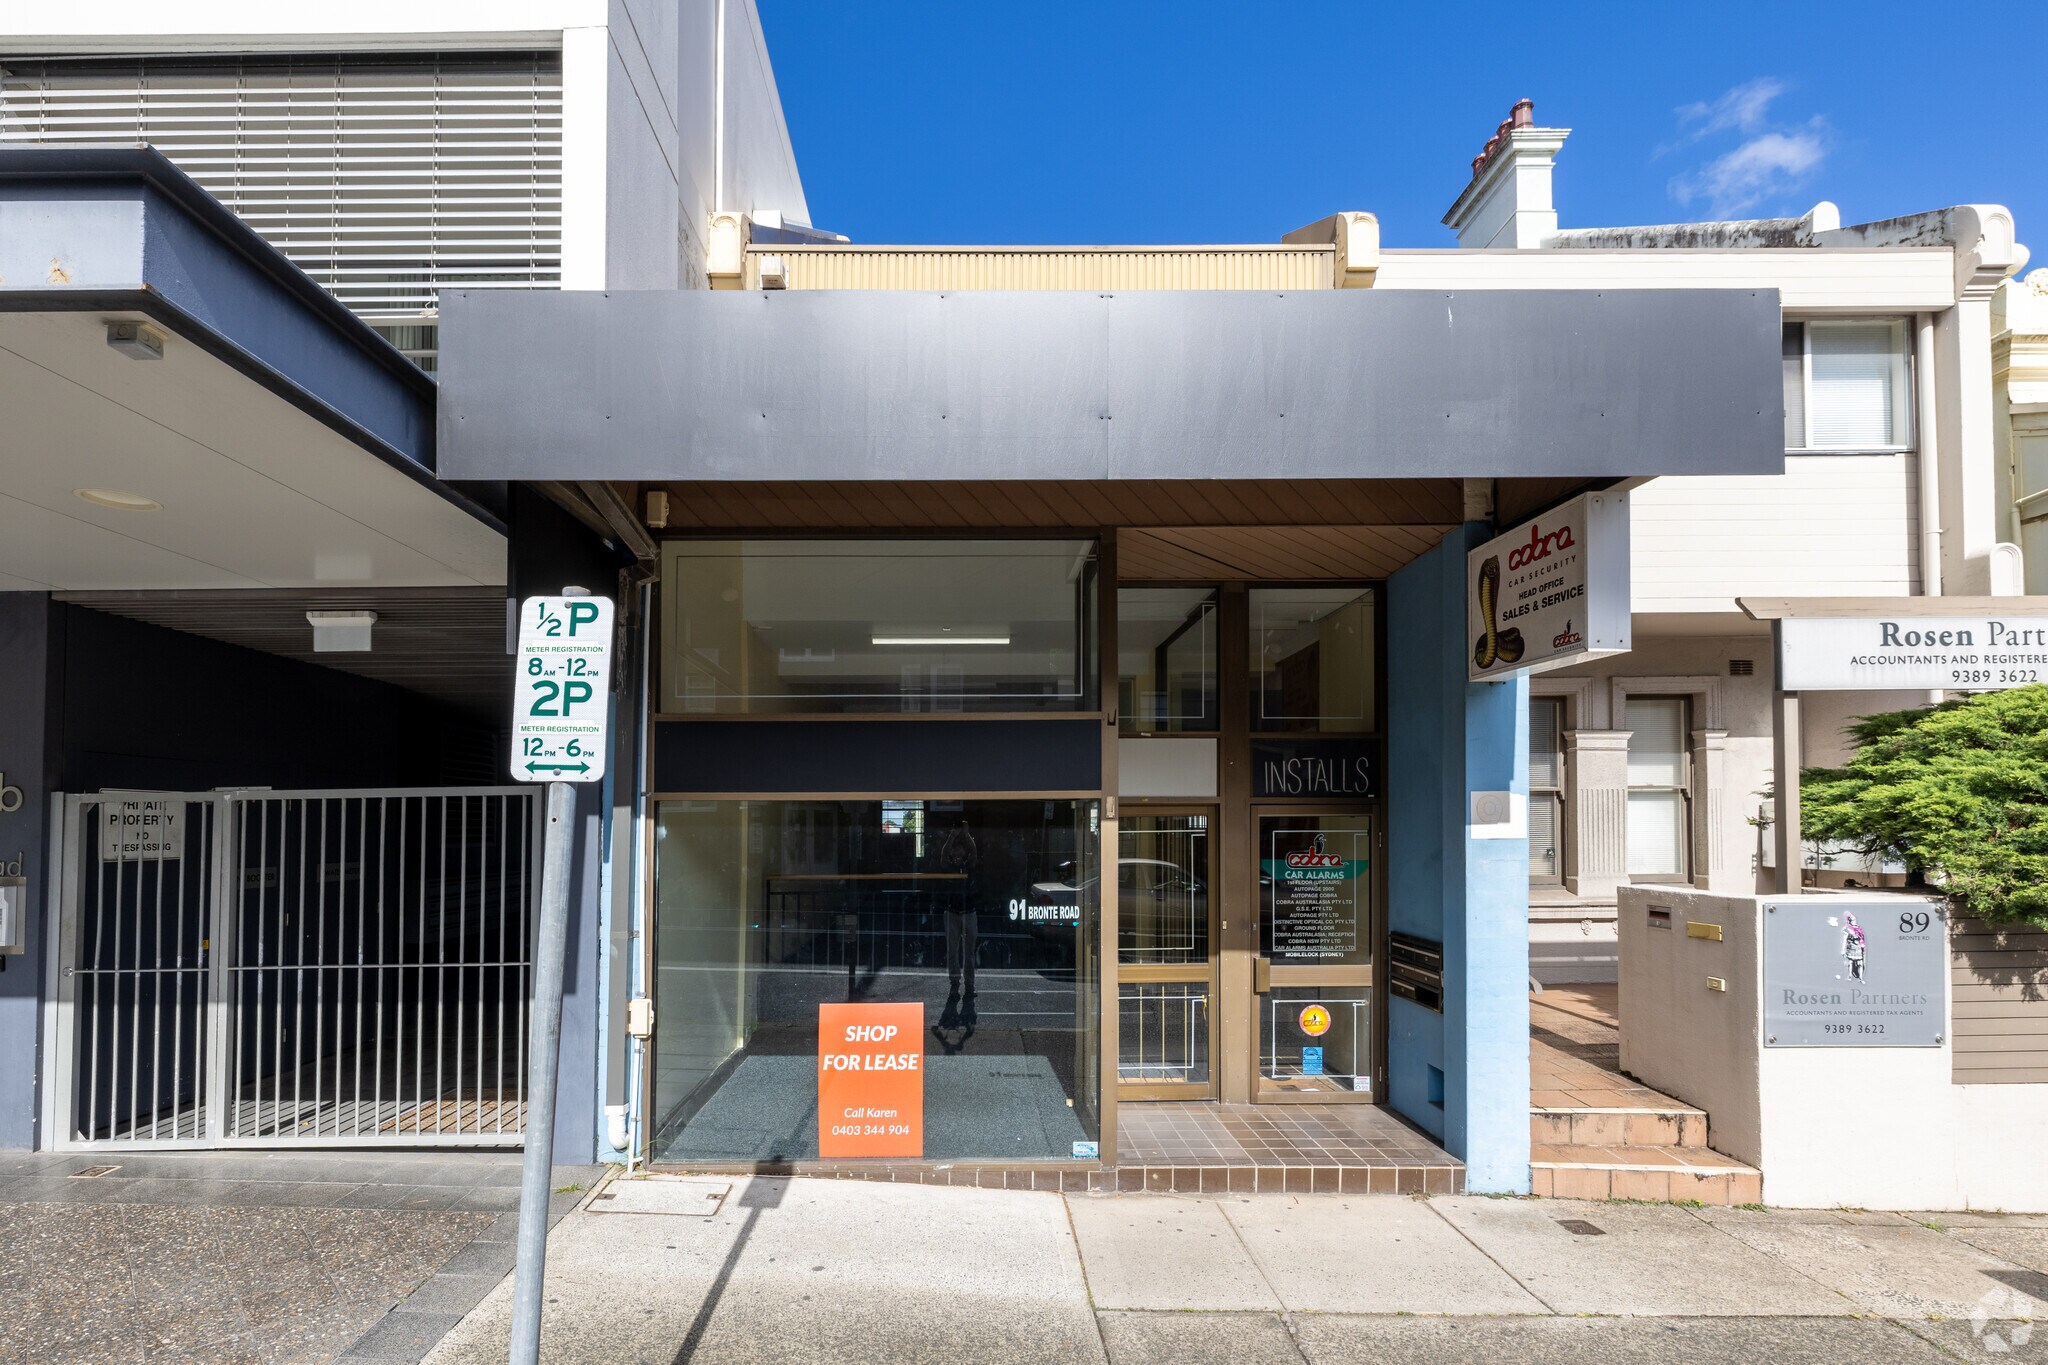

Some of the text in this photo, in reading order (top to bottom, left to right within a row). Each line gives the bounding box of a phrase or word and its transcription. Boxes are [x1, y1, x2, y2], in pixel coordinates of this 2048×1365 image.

[1509, 525, 1575, 571] cobra
[1509, 555, 1576, 588] CAR SECURITY
[1518, 577, 1564, 600] HEAD OFFICE
[1502, 584, 1584, 621] SALES & SERVICE
[1880, 622, 2046, 647] Rosen Part
[1850, 654, 2048, 665] ACCOUNTANTS AND REGISTERE
[1952, 670, 2038, 683] 9389 3622
[530, 680, 592, 716] 2P
[1265, 757, 1368, 793] INSTALLS
[1290, 846, 1344, 867] cobra
[1285, 871, 1344, 879] CAR ALARMS
[1009, 899, 1079, 920] 91 BRONTE ROAD
[1899, 912, 1930, 933] 89
[1783, 989, 1927, 1005] Rosen Partners
[845, 1025, 897, 1042] SHOP
[1825, 1025, 1885, 1034] 9389 3622
[823, 1054, 919, 1071] FOR LEASE
[844, 1108, 897, 1118] Call Karen
[832, 1125, 909, 1136] 0403 344 904
